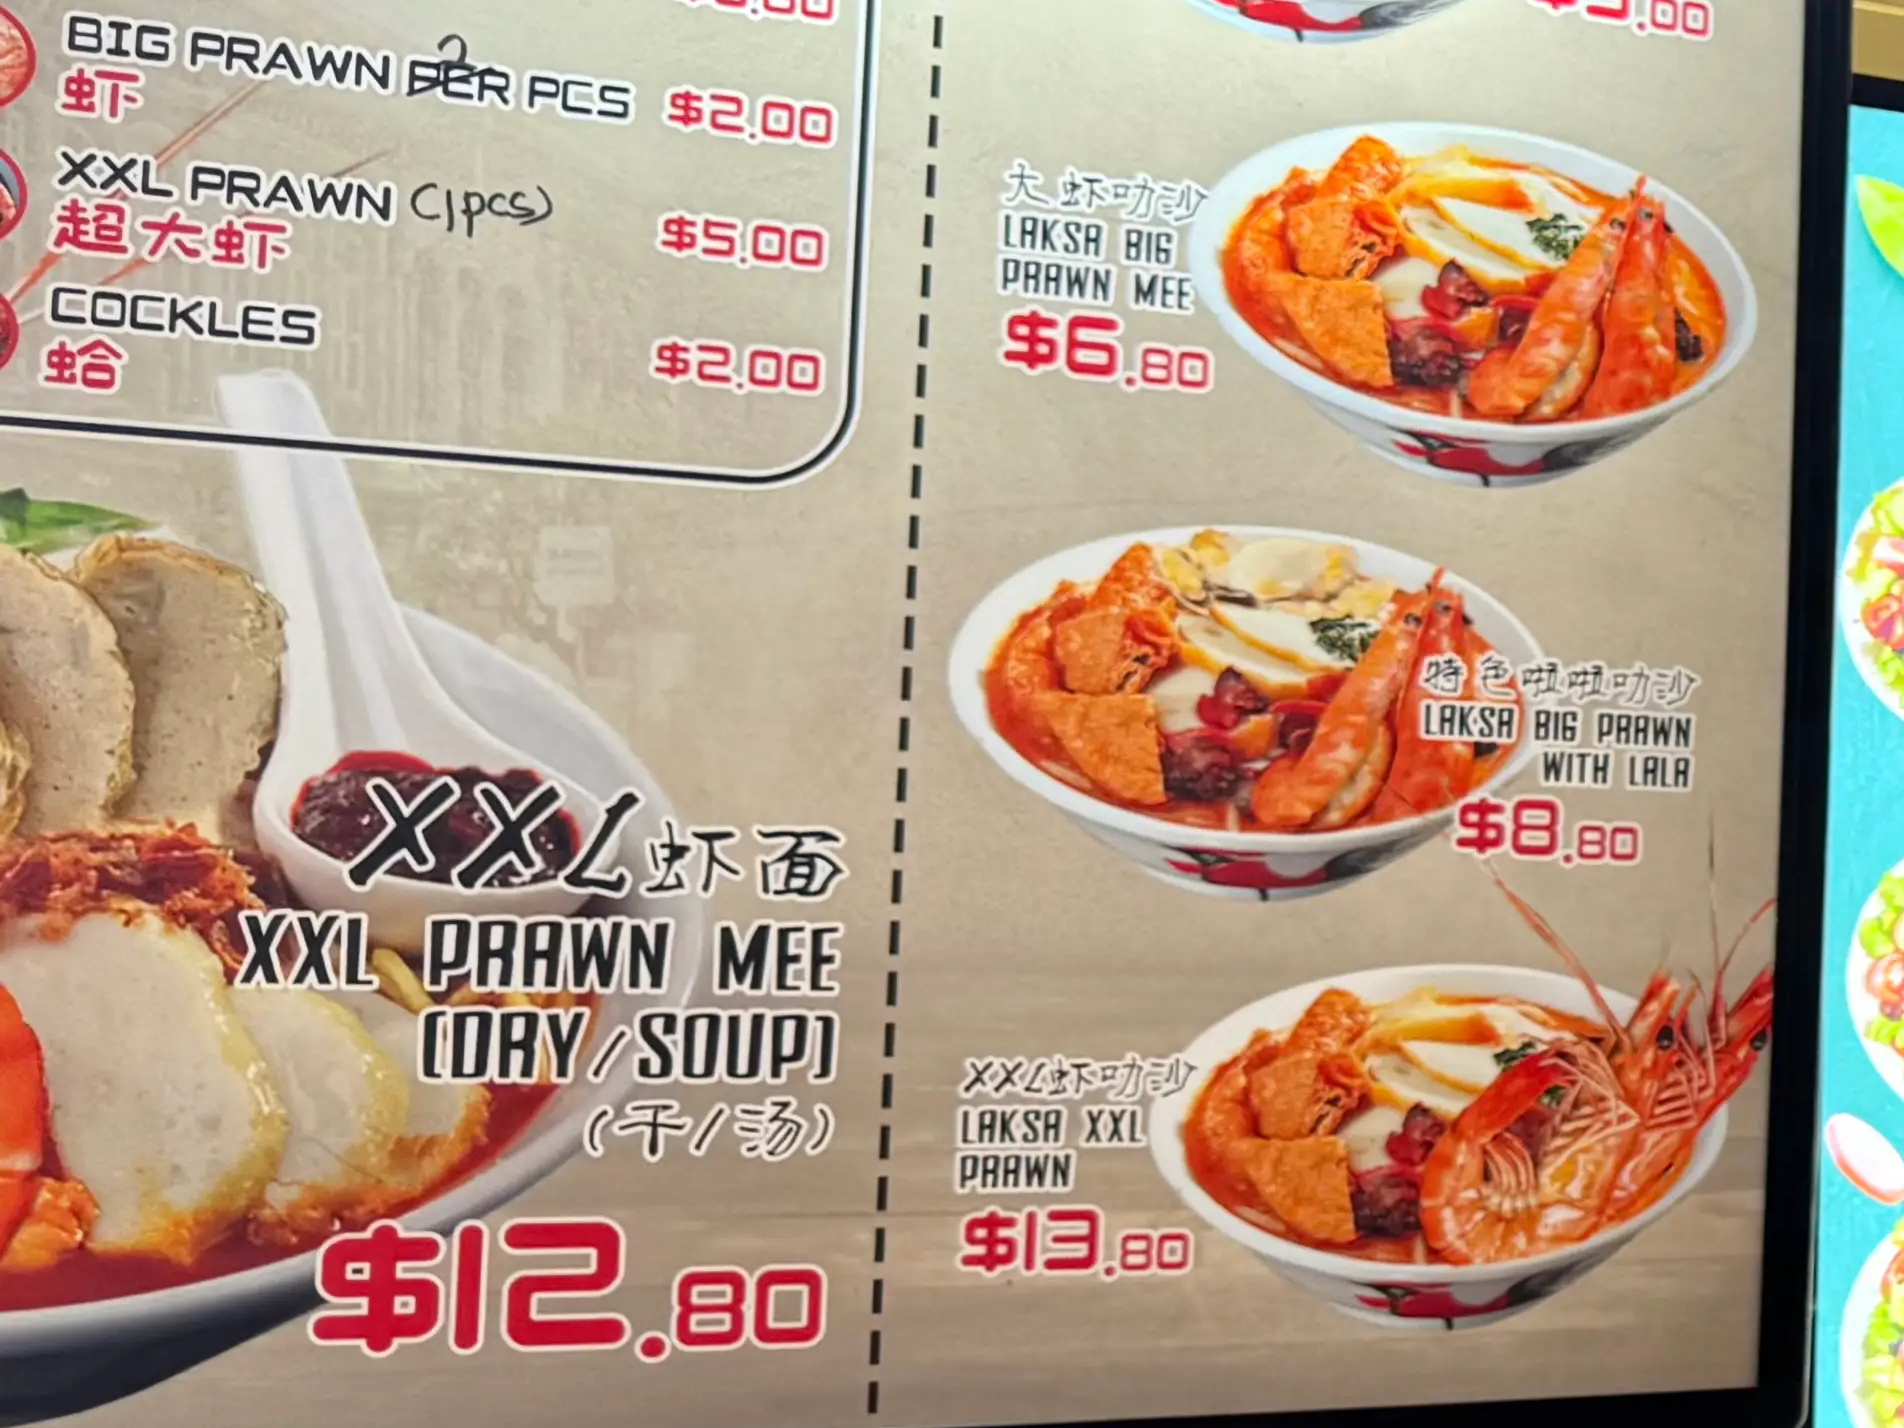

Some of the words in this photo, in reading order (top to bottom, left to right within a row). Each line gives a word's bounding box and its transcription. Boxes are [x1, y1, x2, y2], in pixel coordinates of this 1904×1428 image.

[60, 68, 143, 122] 虾
[67, 15, 173, 64] BIG
[189, 30, 394, 91] PRAWN
[527, 78, 634, 122] PCS
[666, 87, 834, 148] $2.00
[57, 151, 178, 199] XXL
[190, 164, 393, 224] PRAWN
[1004, 161, 1208, 222] 大虾叻沙
[52, 202, 290, 271] 超大虾
[658, 212, 826, 270] $5.00
[1003, 212, 1103, 255] LAKSA
[1124, 224, 1175, 267] BIG
[1001, 256, 1113, 304] PRAWN
[1131, 269, 1194, 312] MEE
[50, 285, 321, 348] COCKLES
[42, 339, 123, 394] 蛤
[652, 338, 824, 395] $2.00
[1002, 311, 1212, 393] $6.80
[1424, 703, 1516, 740] LAKSA
[1534, 710, 1579, 743] BIG
[1597, 713, 1693, 749] PRAWN
[1542, 751, 1611, 787] WITH
[1628, 755, 1692, 788] LALA
[1454, 798, 1640, 865] $8.80
[240, 912, 376, 989] XXL
[430, 917, 669, 993] PRAWN
[718, 925, 842, 994] MEE
[960, 1107, 1062, 1147] LAKSA
[1083, 1107, 1144, 1145] XXL
[959, 1153, 1073, 1193] PRAWN
[959, 1206, 1191, 1280] $13.80
[310, 1219, 826, 1360] $12.80
